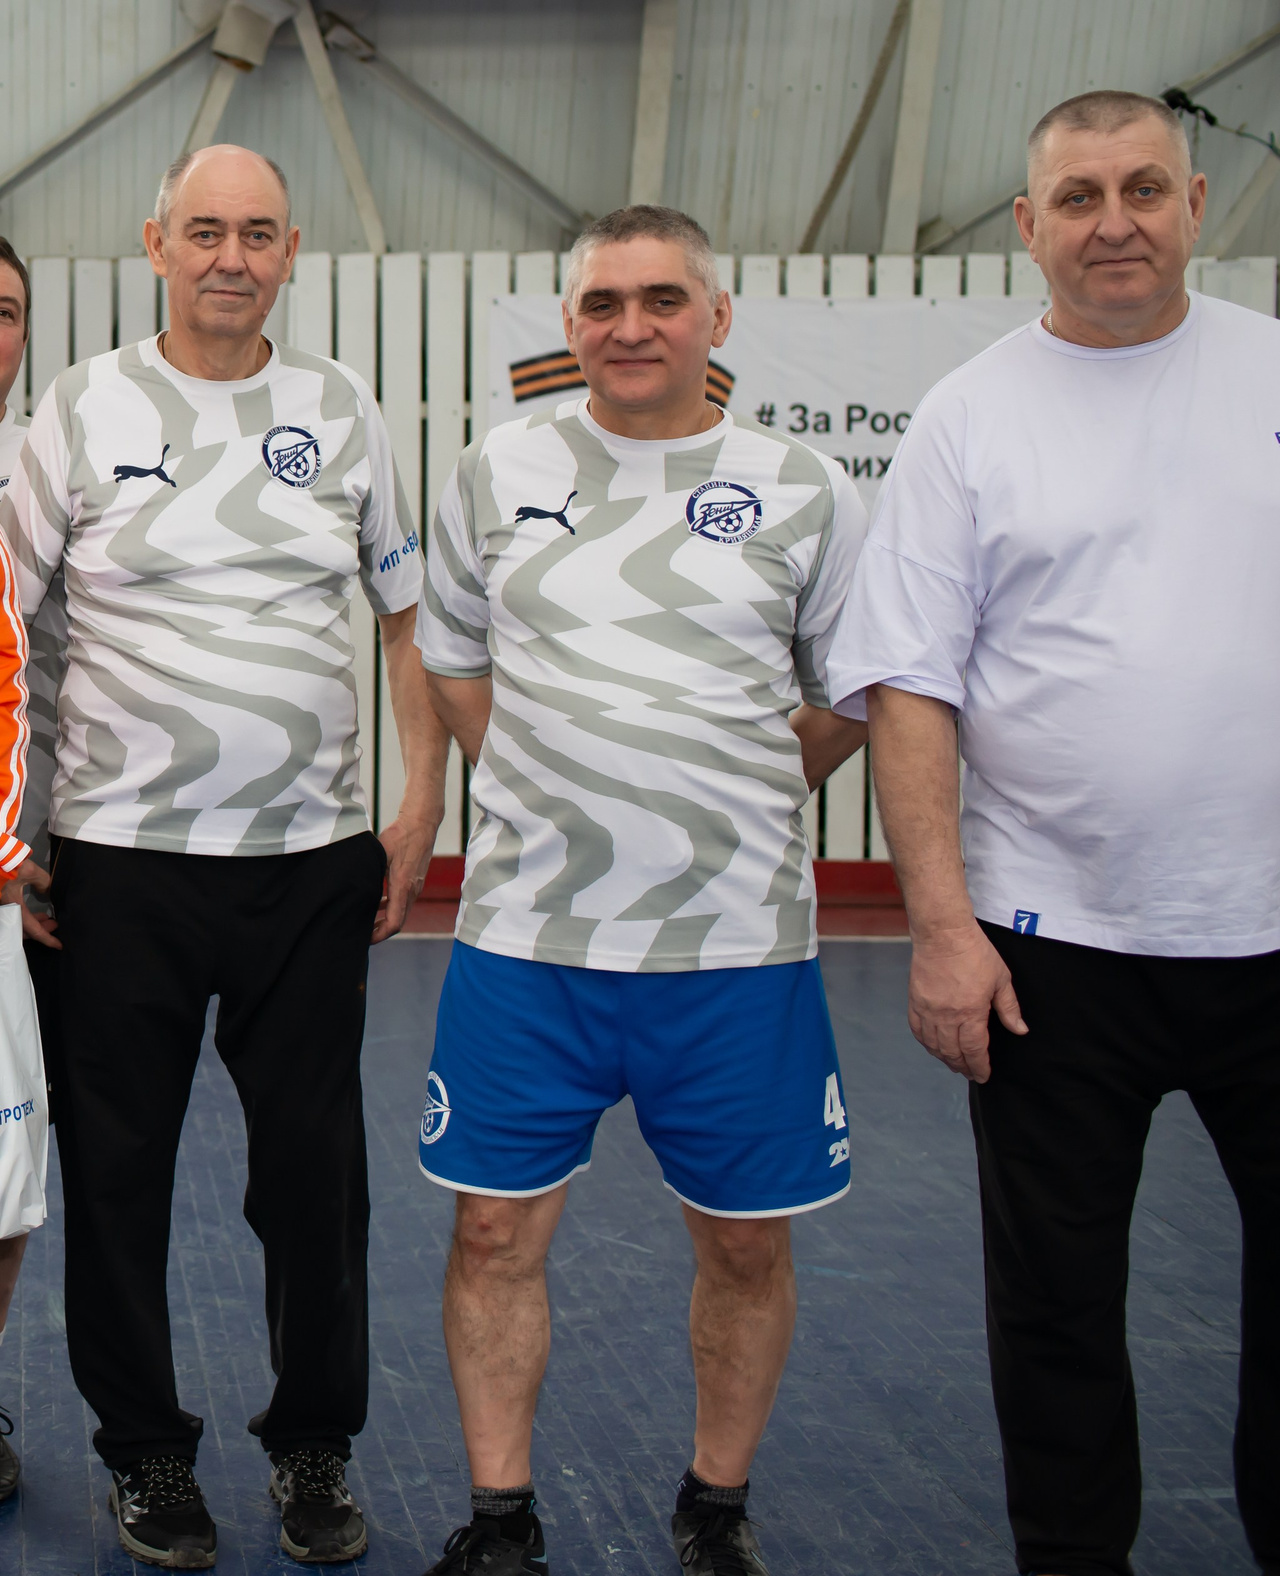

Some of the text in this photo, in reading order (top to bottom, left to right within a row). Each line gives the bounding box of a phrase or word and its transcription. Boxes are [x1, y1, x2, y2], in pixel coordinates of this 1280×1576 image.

[788, 403, 831, 434] За
[846, 403, 911, 434] Рос
[692, 481, 731, 499] СТАНИЦА
[718, 514, 762, 544] КРИВЯНСКАЯ
[380, 548, 400, 573] ИП
[824, 1072, 846, 1130] 4
